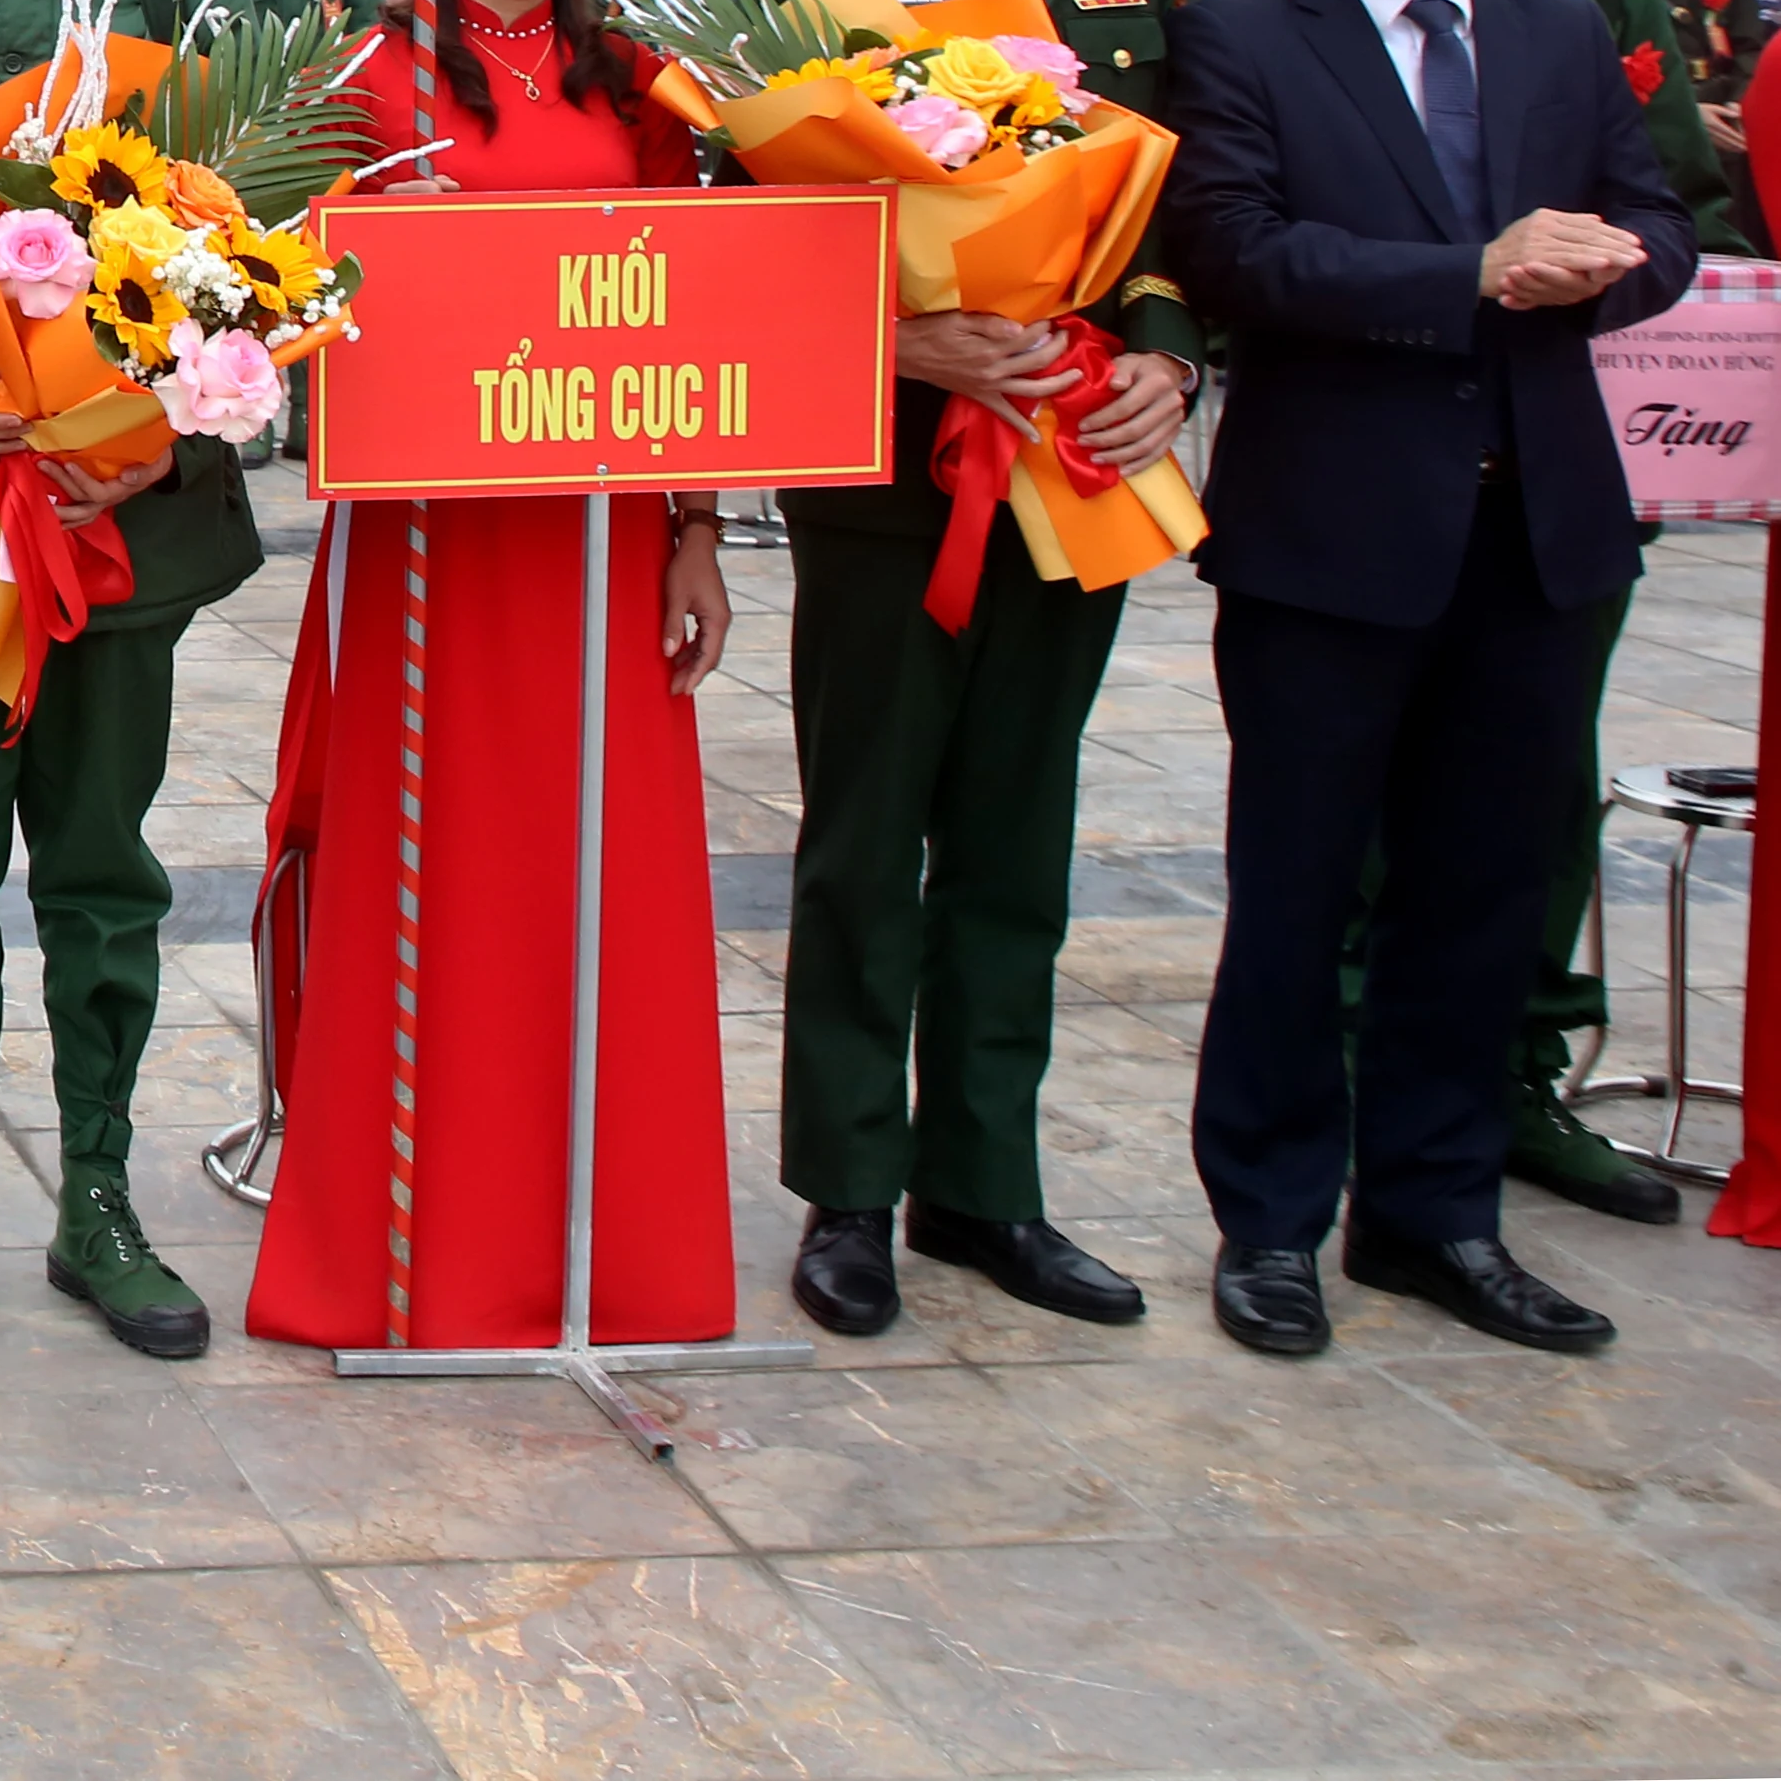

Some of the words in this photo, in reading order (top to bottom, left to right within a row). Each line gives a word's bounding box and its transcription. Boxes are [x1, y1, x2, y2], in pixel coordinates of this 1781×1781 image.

[558, 226, 667, 329] KHỐI
[474, 338, 596, 445] TỔNG
[611, 363, 704, 456] CỤC
[718, 362, 749, 437] II
[1624, 403, 1753, 456] Tặng
